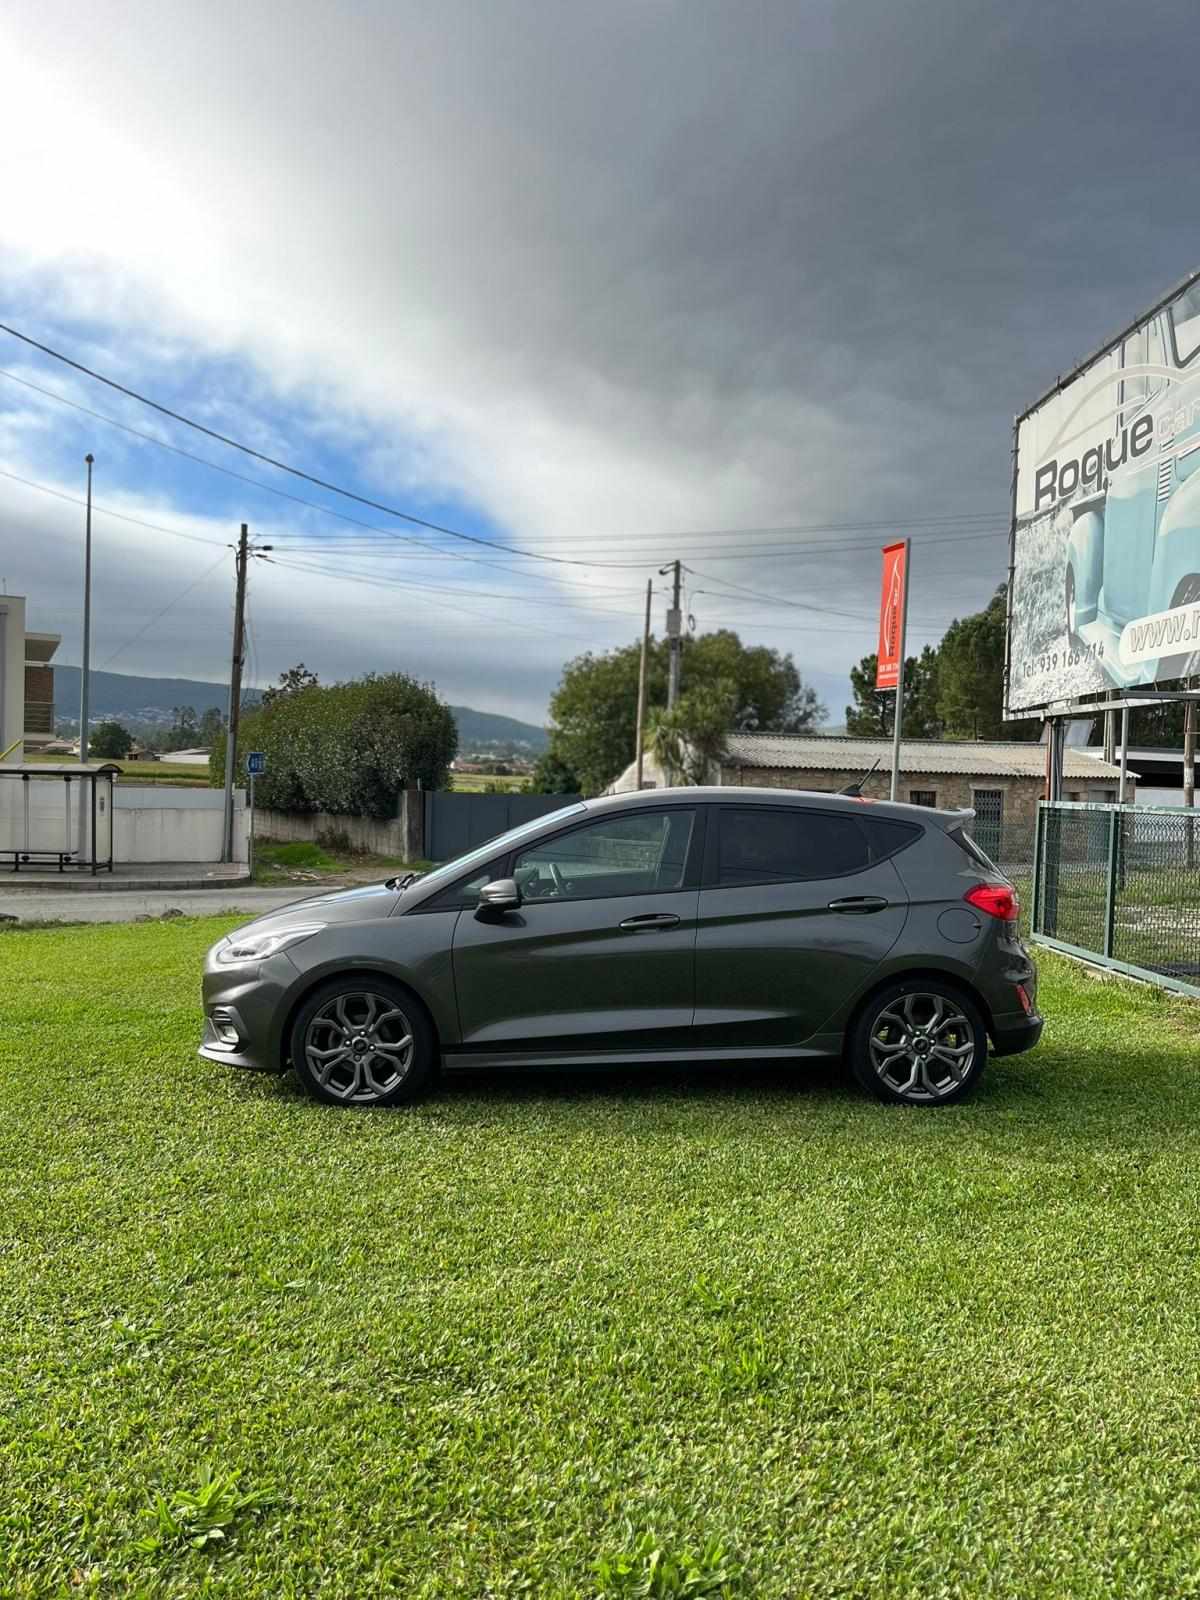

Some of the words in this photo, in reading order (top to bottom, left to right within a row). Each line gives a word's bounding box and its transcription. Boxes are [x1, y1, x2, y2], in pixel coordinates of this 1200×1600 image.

[1034, 414, 1153, 512] Roque
[1040, 653, 1058, 672] 939
[1062, 648, 1080, 668] 166
[1084, 641, 1105, 664] 714
